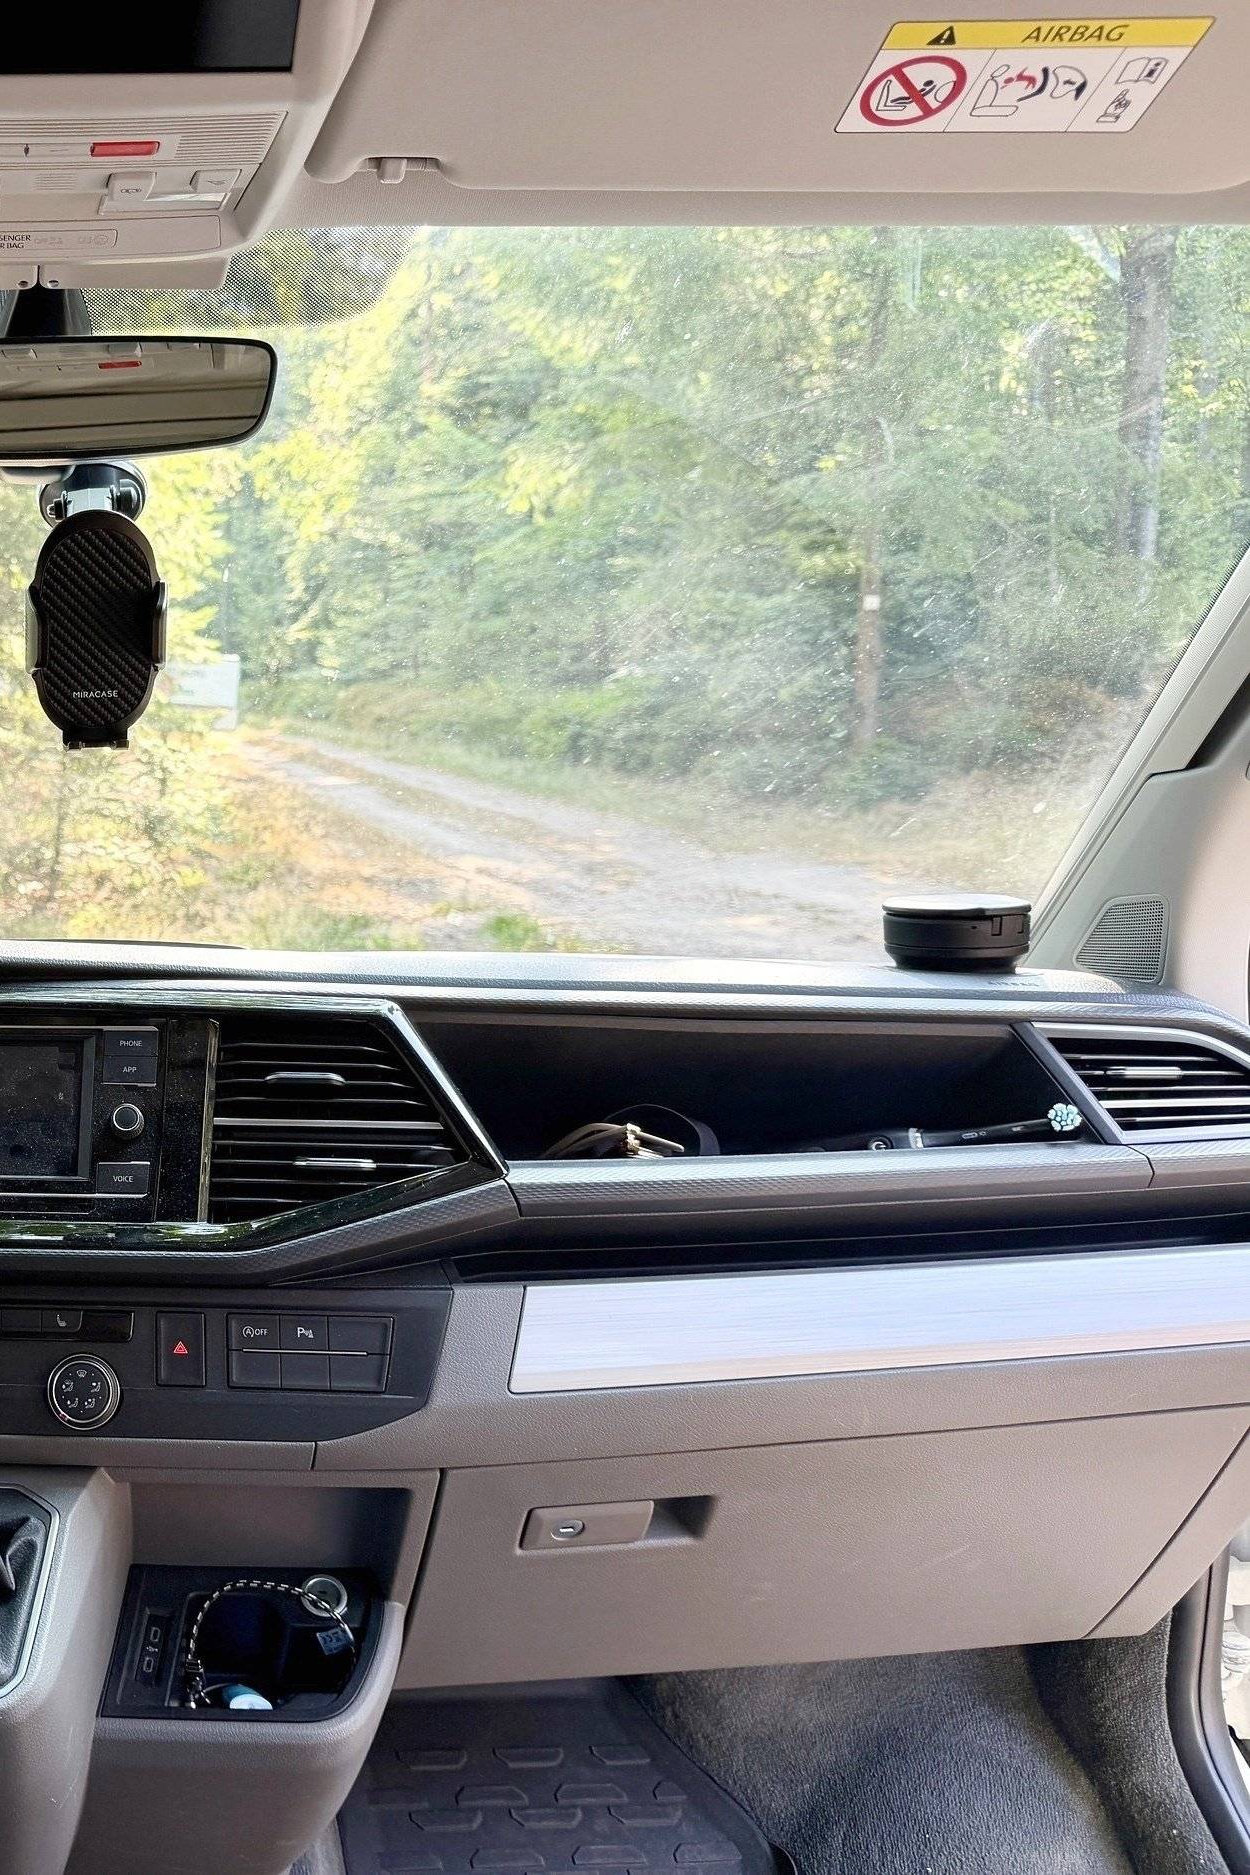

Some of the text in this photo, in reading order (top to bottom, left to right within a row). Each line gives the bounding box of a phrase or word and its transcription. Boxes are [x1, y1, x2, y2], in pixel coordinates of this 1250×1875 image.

[1020, 24, 1130, 43] AIRBAG
[72, 690, 119, 699] MIRACASE
[112, 1175, 134, 1183] VOICE
[254, 1328, 268, 1336] OFF
